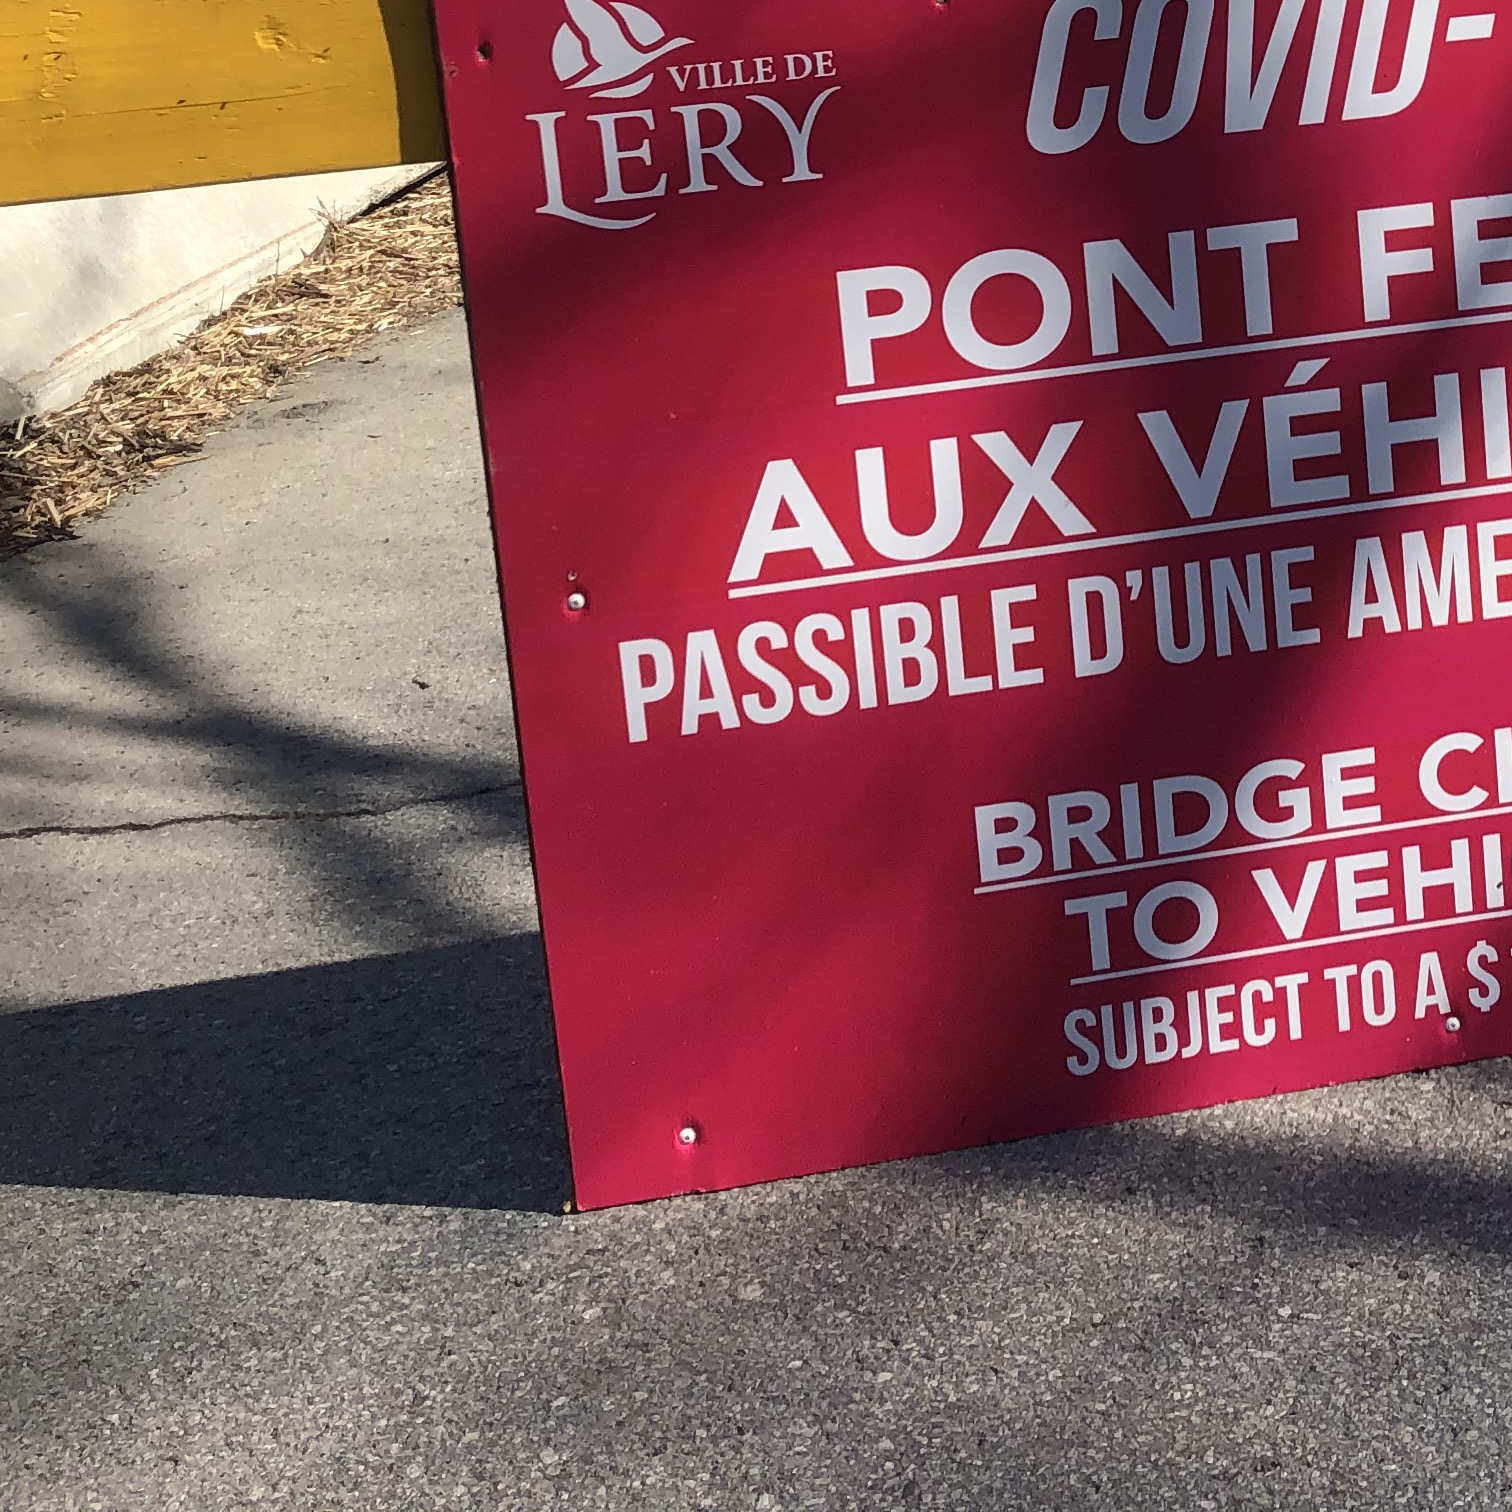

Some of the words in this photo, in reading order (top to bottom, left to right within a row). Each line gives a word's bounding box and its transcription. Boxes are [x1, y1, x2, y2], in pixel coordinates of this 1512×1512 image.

[666, 56, 777, 92] VILLE
[783, 50, 837, 82] DE
[525, 85, 841, 230] LERY
[836, 217, 1299, 388] PONT
[727, 420, 1097, 584] AUX
[617, 583, 1045, 744] PASSIBLE
[1067, 549, 1324, 679] D'UNE
[975, 746, 1382, 883] BRIDGE
[1065, 874, 1219, 971] TO
[1064, 971, 1309, 1077] SUBJECT
[1323, 959, 1397, 1033] TO
[1414, 951, 1452, 1020] A
